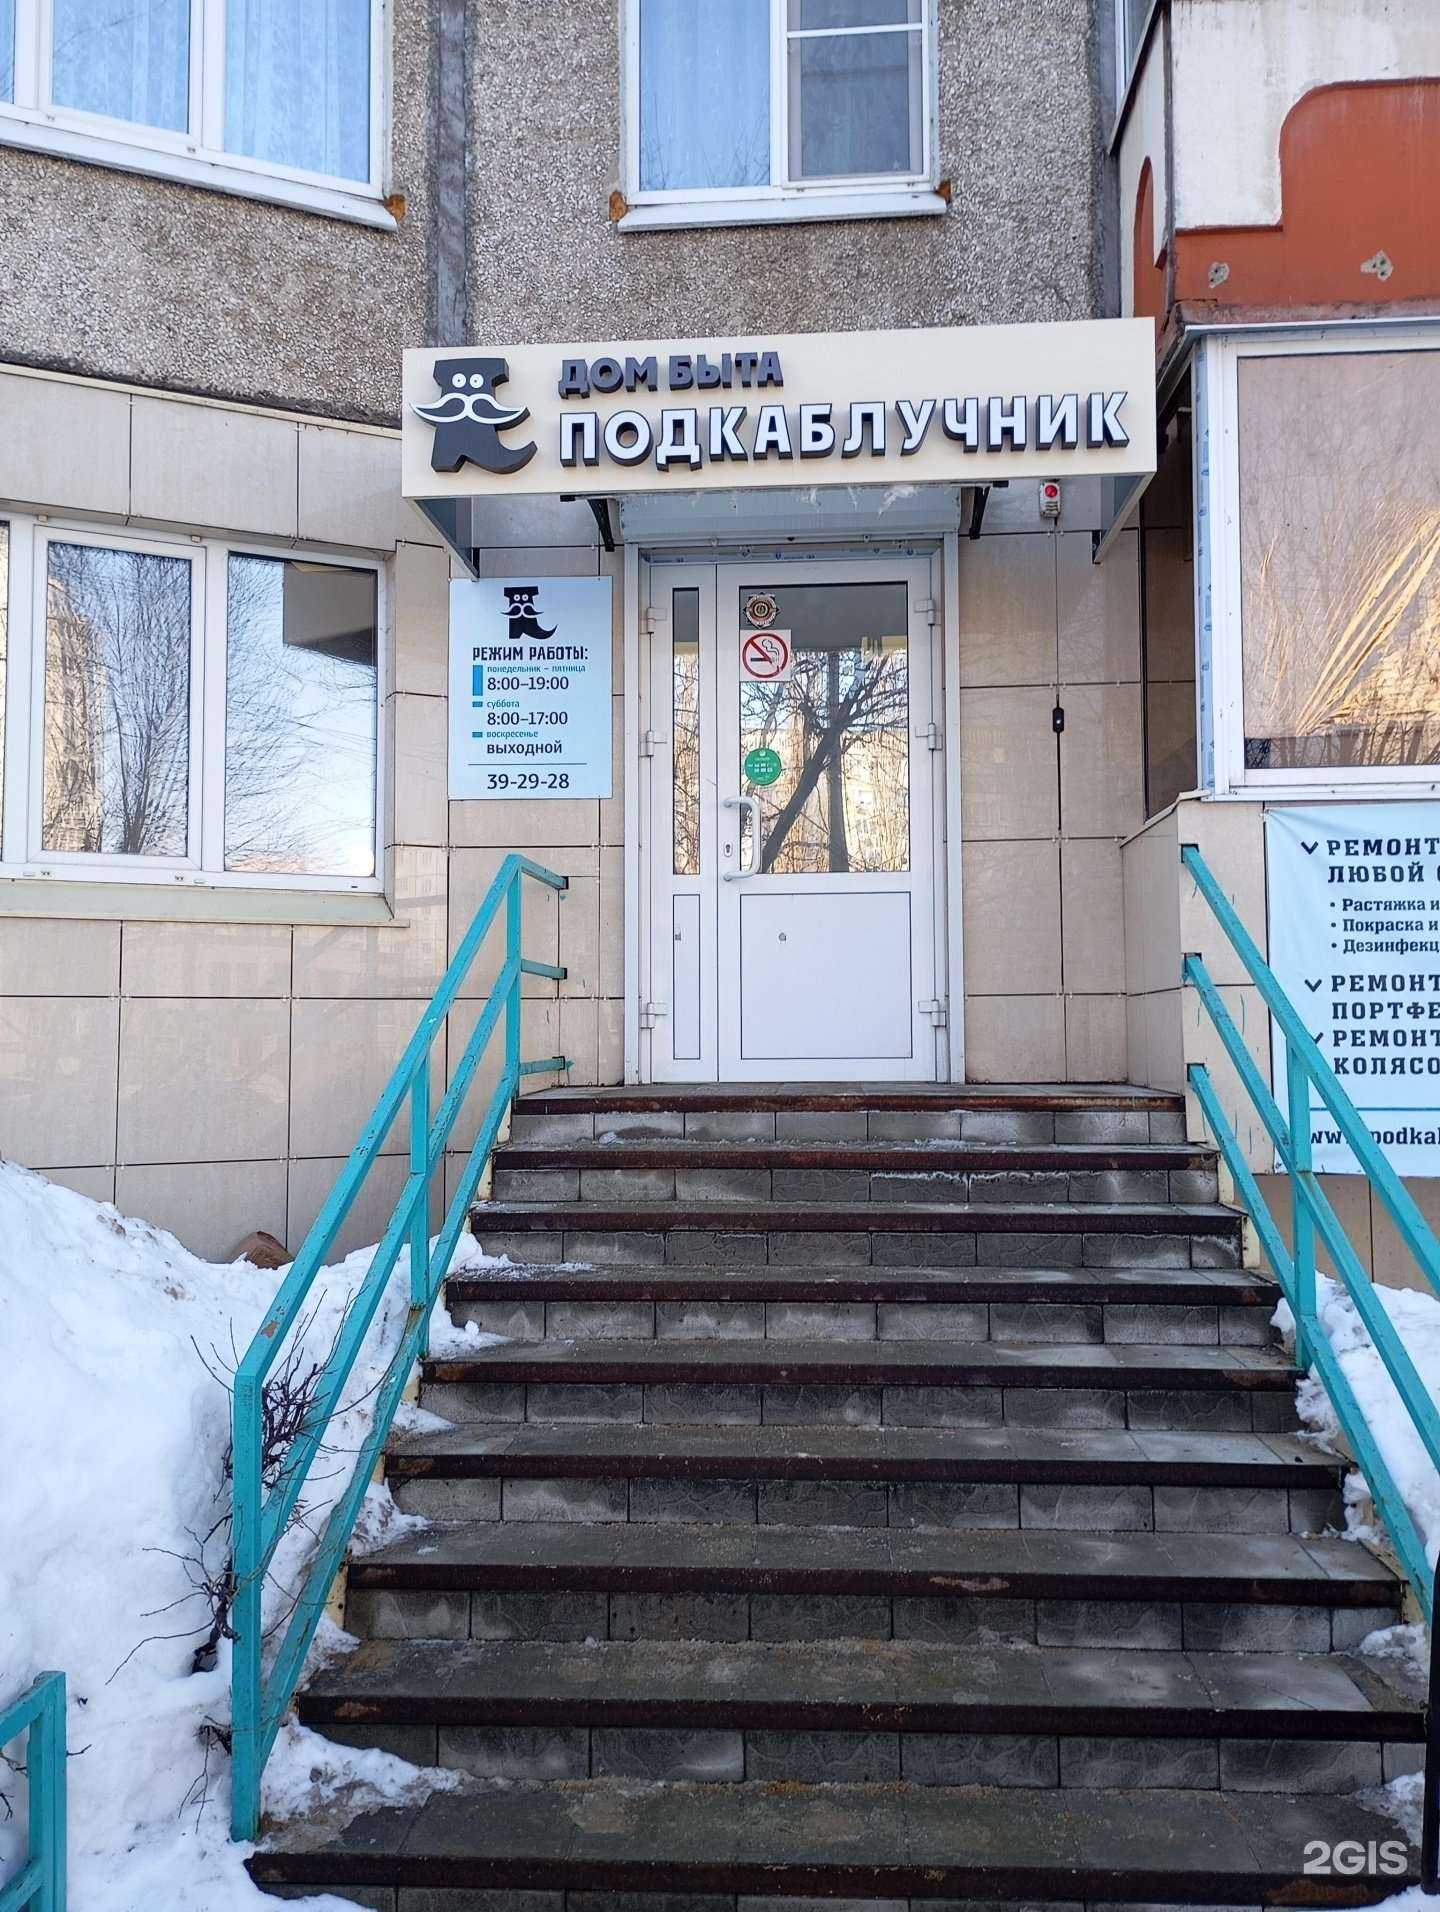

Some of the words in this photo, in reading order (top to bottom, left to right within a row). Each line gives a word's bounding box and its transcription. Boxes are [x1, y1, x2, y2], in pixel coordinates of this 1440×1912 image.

[558, 355, 658, 399] ДОМ
[668, 351, 784, 391] БЫТА
[559, 391, 1130, 472] ПОДКАБЛУЧНИК
[472, 646, 524, 661] РЕЖИМ
[529, 646, 588, 661] РАБОТЫ:
[487, 665, 541, 673] понедельник
[552, 664, 586, 673] пятница
[487, 700, 520, 709] суббота
[486, 731, 539, 740] воскресенье
[487, 773, 570, 790] 39-29-28
[1327, 838, 1440, 856] РЕМОНТ
[1328, 861, 1425, 883] ЛЮБОЙ
[1342, 898, 1426, 912] Растяжка
[1343, 918, 1424, 935] Покраска
[1331, 974, 1440, 992] РЕМОНТ
[1332, 1001, 1440, 1020] ПОРТФЕ
